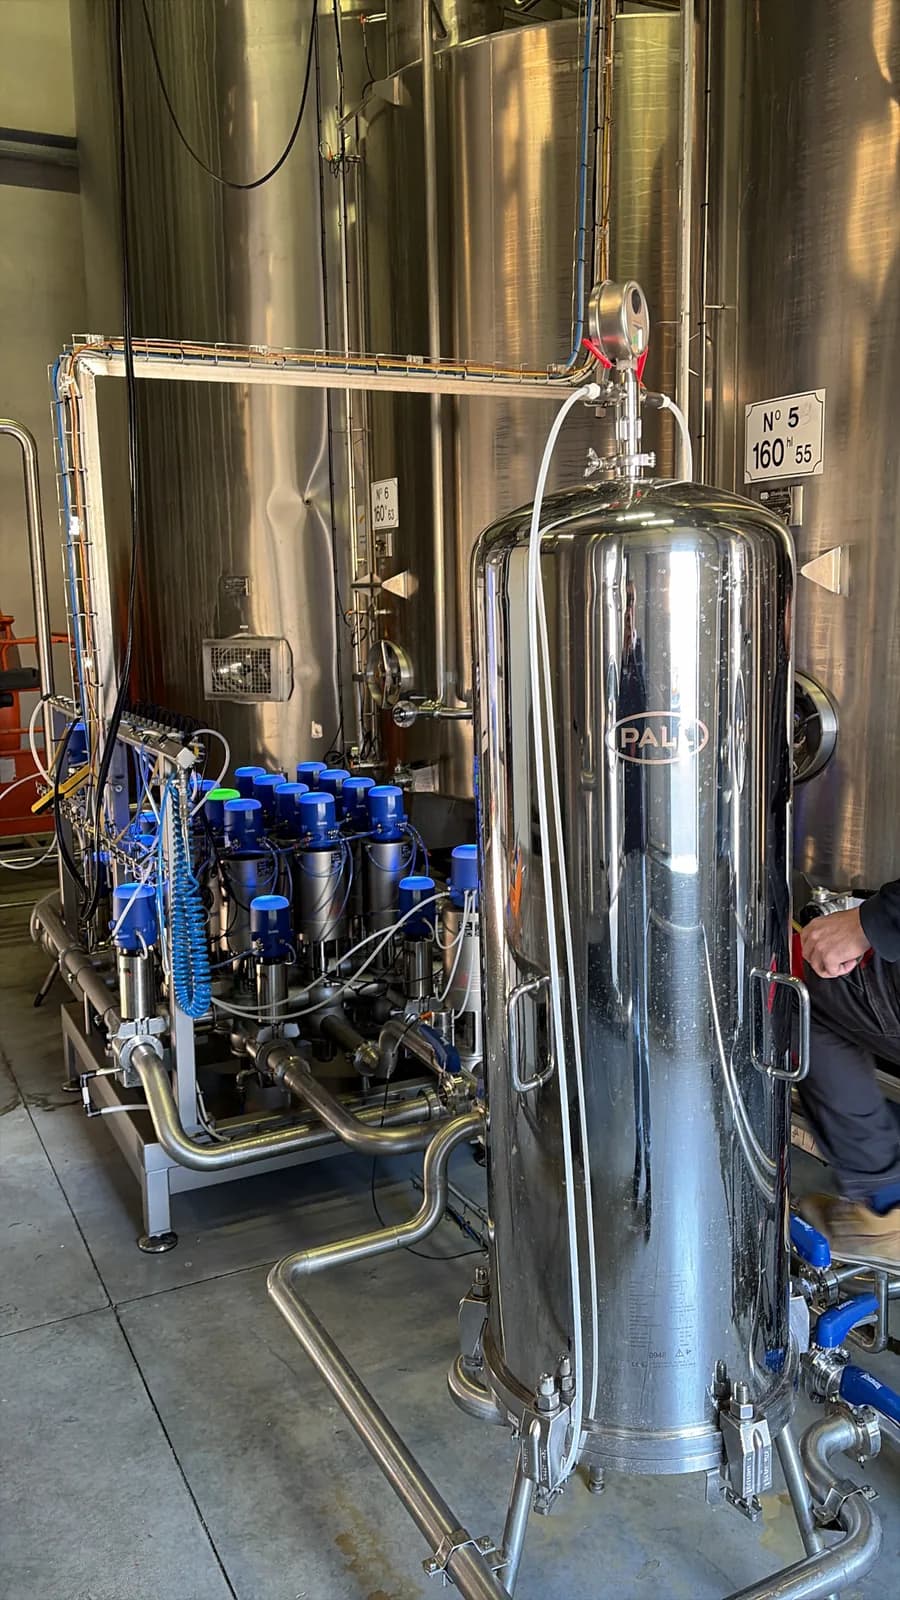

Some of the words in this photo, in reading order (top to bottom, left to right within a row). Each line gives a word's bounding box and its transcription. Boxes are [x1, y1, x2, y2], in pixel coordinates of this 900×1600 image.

[788, 406, 799, 428] 5
[753, 438, 784, 470] 160
[795, 444, 812, 464] 55
[384, 486, 389, 499] 6
